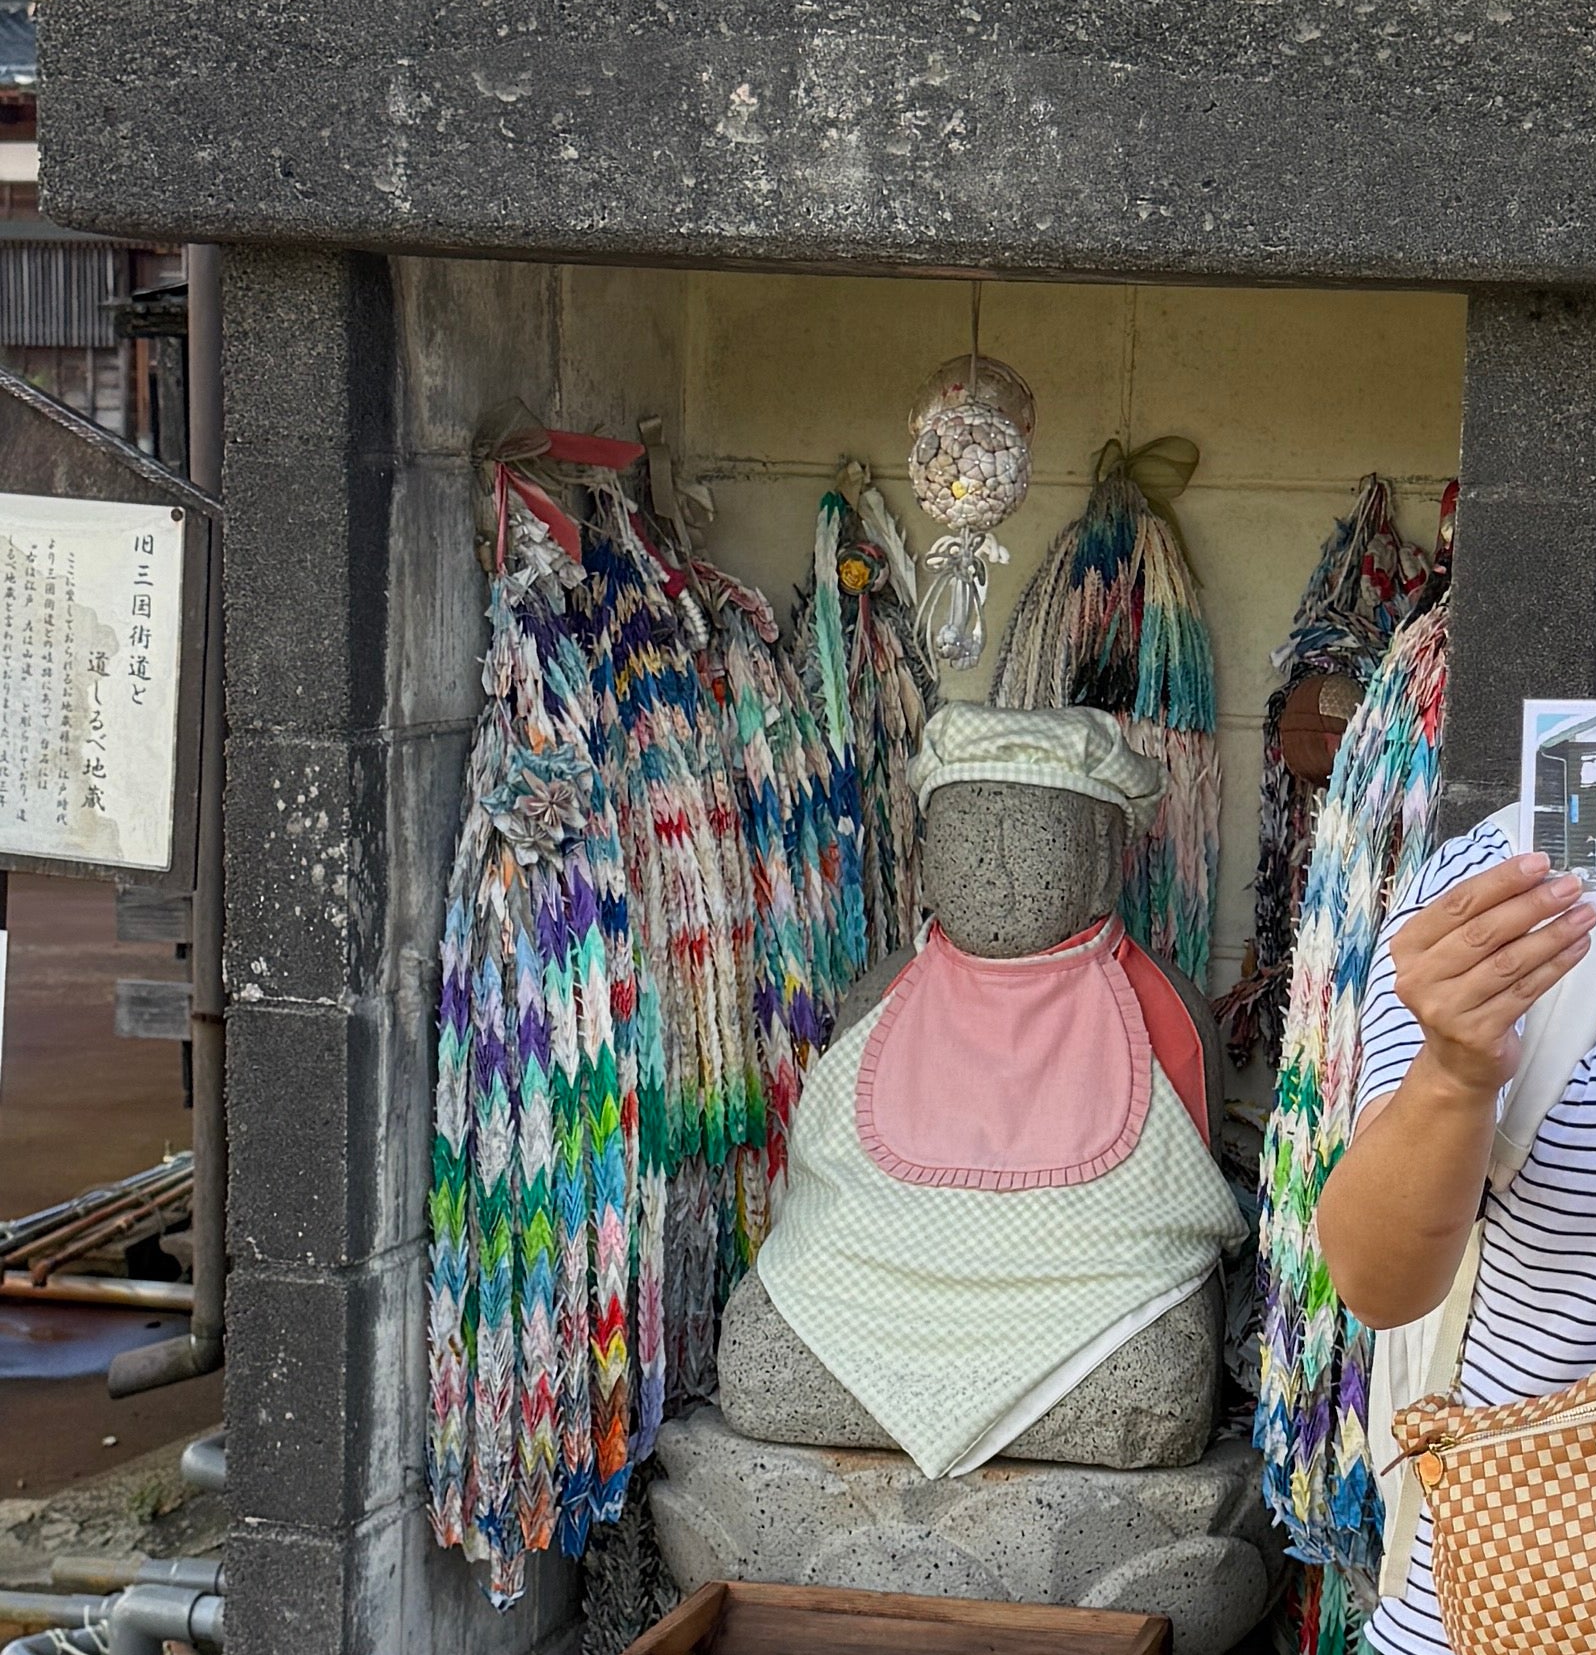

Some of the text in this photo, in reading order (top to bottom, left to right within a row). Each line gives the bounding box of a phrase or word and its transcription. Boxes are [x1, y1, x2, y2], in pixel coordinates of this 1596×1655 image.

[127, 535, 155, 705] 旧三国街道と
[81, 651, 111, 812] 道しるべ地蔵
